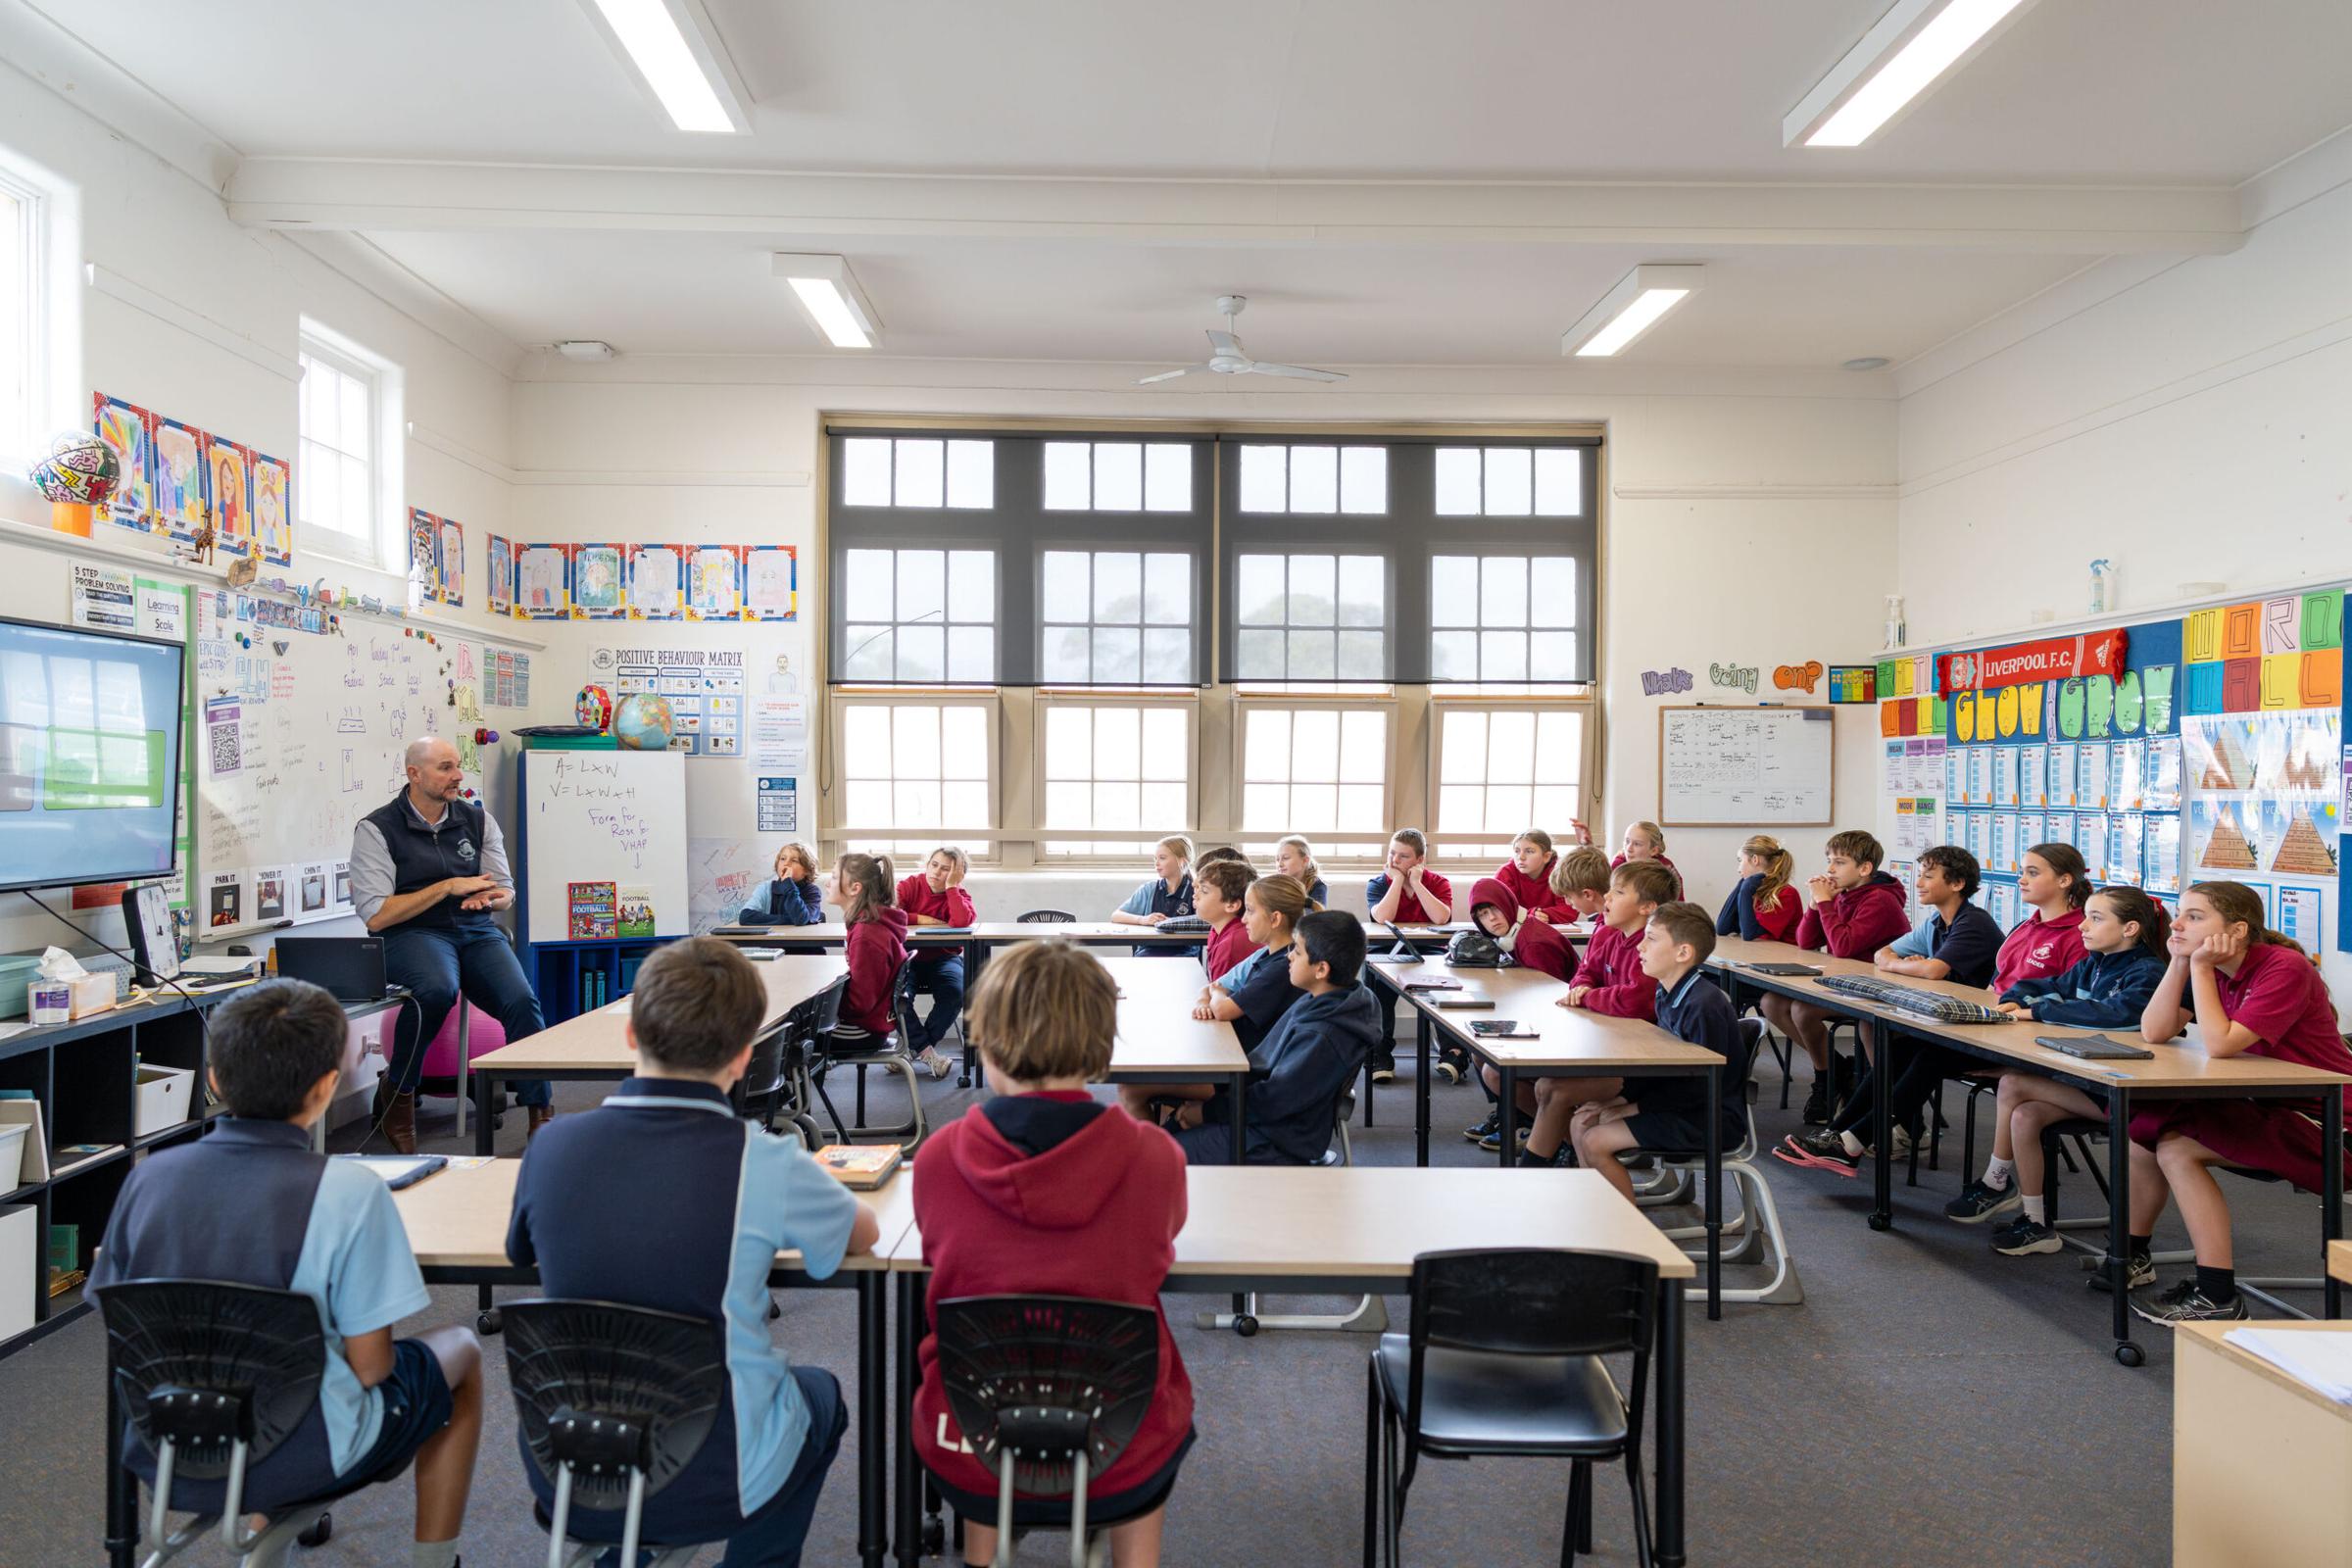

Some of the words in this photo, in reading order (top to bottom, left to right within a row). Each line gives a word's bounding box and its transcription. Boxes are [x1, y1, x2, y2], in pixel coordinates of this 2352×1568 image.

[74, 566, 80, 576] 5
[81, 567, 99, 578] STEP
[74, 576, 104, 589] PROBLEM
[105, 581, 129, 593] SOLVING
[147, 598, 178, 613] Learning
[155, 618, 173, 631] Scale
[615, 650, 655, 664] POSITIVE
[658, 650, 705, 665] BEHAVIOUR
[709, 652, 743, 666] MATRIX
[1985, 655, 2048, 678] LIVERPOOL
[2050, 652, 2072, 669] F.C.
[1641, 667, 1693, 696] What's
[1709, 662, 1758, 695] Going
[1773, 661, 1823, 695] On?
[2190, 654, 2331, 712] WALL
[2060, 666, 2175, 738] GROW
[1955, 683, 2044, 742] GLOW
[621, 807, 635, 824] for
[612, 824, 634, 838] Rose
[216, 875, 229, 884] PARK
[229, 874, 235, 883] IT
[572, 904, 606, 913] FOOTBALL
[2026, 957, 2045, 969] LEADER
